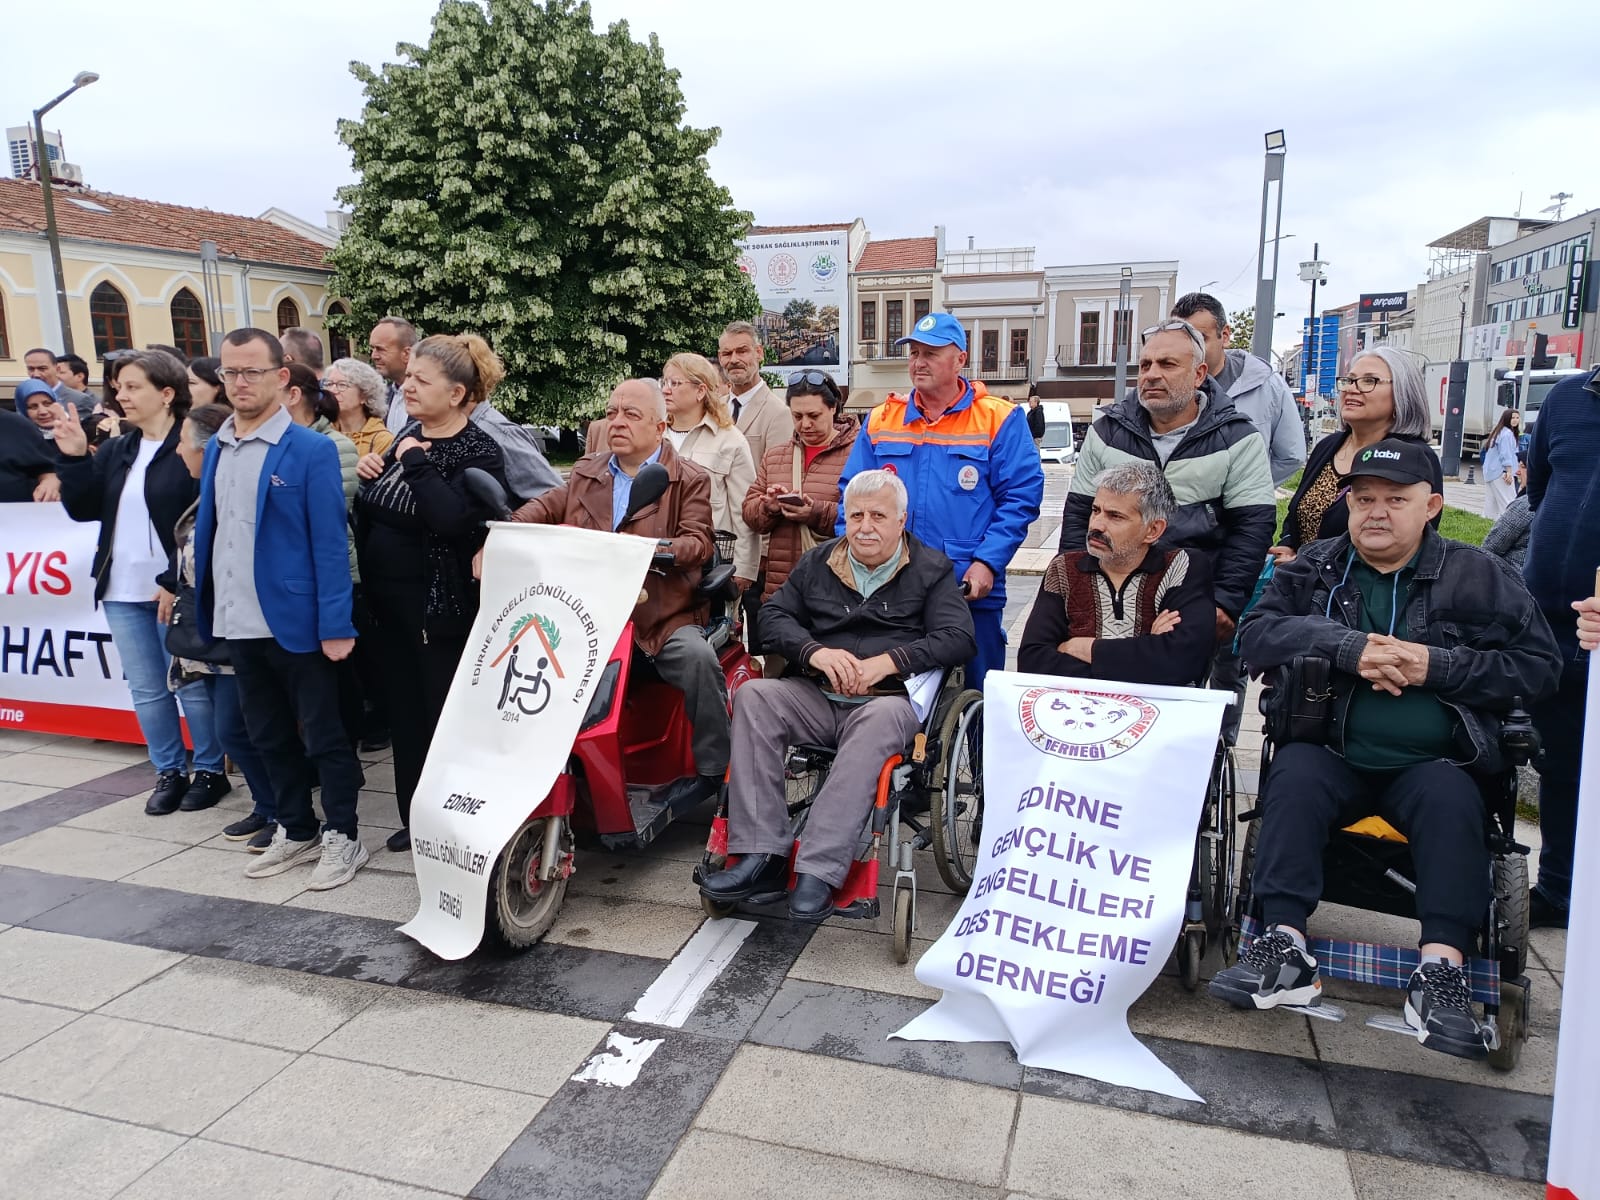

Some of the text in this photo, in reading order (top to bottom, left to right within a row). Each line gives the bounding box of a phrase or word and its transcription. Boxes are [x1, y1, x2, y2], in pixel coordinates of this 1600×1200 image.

[1373, 296, 1404, 307] arçelik
[1567, 246, 1584, 327] HOTEL
[2, 626, 128, 680] HAFT
[471, 634, 493, 686] EDİRNE
[491, 587, 528, 633] ENGELLİ
[529, 582, 599, 637] GÖNÜLLÜLERİ
[502, 711, 520, 723] 2014
[442, 792, 486, 815] EDİRNE
[1017, 781, 1123, 830] EDİRNE
[414, 838, 491, 876] ENGELLİ GÖNÜLLÜLERİ
[991, 826, 1152, 883] GENÇLİK VE
[439, 890, 462, 920] DERNEĞİ
[974, 867, 1155, 920] ENGELLİLERİ
[954, 909, 1151, 965] DESTEKLEME
[956, 952, 1106, 1005] DERNEĞİ
